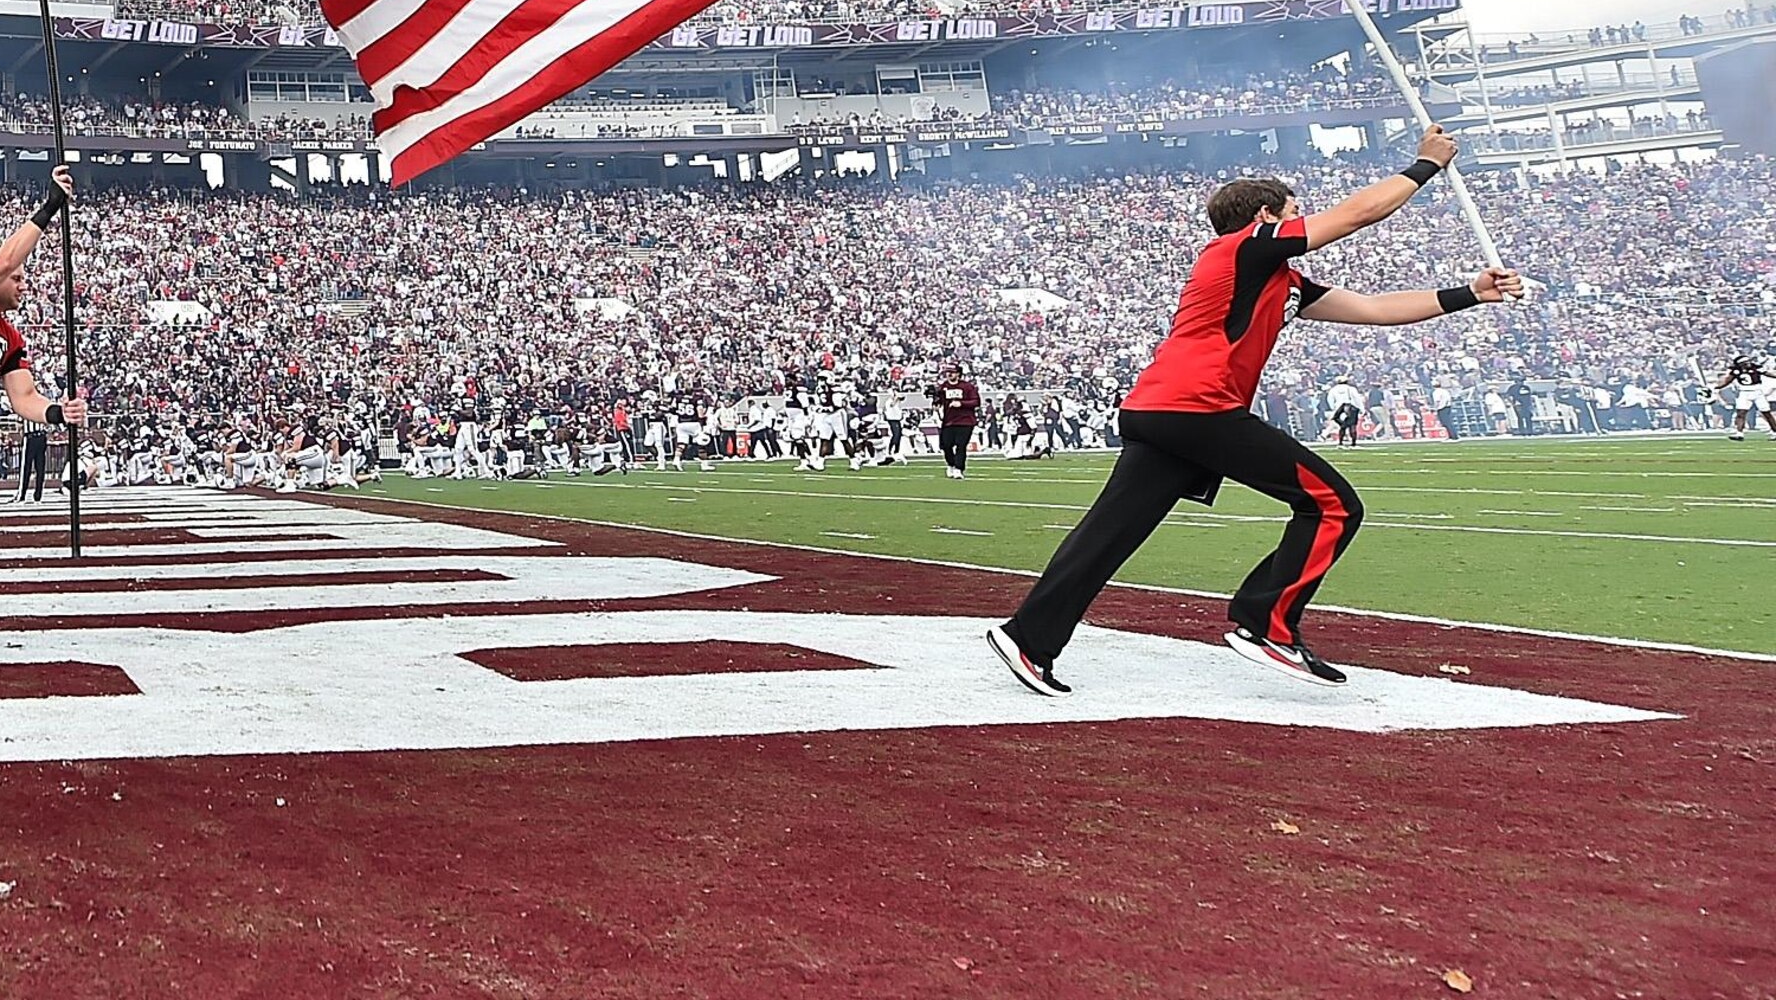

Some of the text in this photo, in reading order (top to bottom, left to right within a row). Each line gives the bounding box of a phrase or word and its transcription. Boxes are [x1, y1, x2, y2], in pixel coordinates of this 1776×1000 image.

[1136, 8, 1185, 28] GET
[1187, 5, 1244, 26] LOUD
[101, 19, 197, 44] GET LOUD
[897, 19, 997, 41] GET LOUD
[717, 26, 761, 47] GET
[764, 26, 812, 46] LOUD
[1138, 122, 1164, 131] DAVIS
[817, 135, 844, 145] LEWIS
[918, 132, 951, 141] SHORTY
[187, 141, 256, 150] JOE FORTUNATO
[292, 141, 354, 150] JACKIE PARKER
[677, 402, 695, 416] 56
